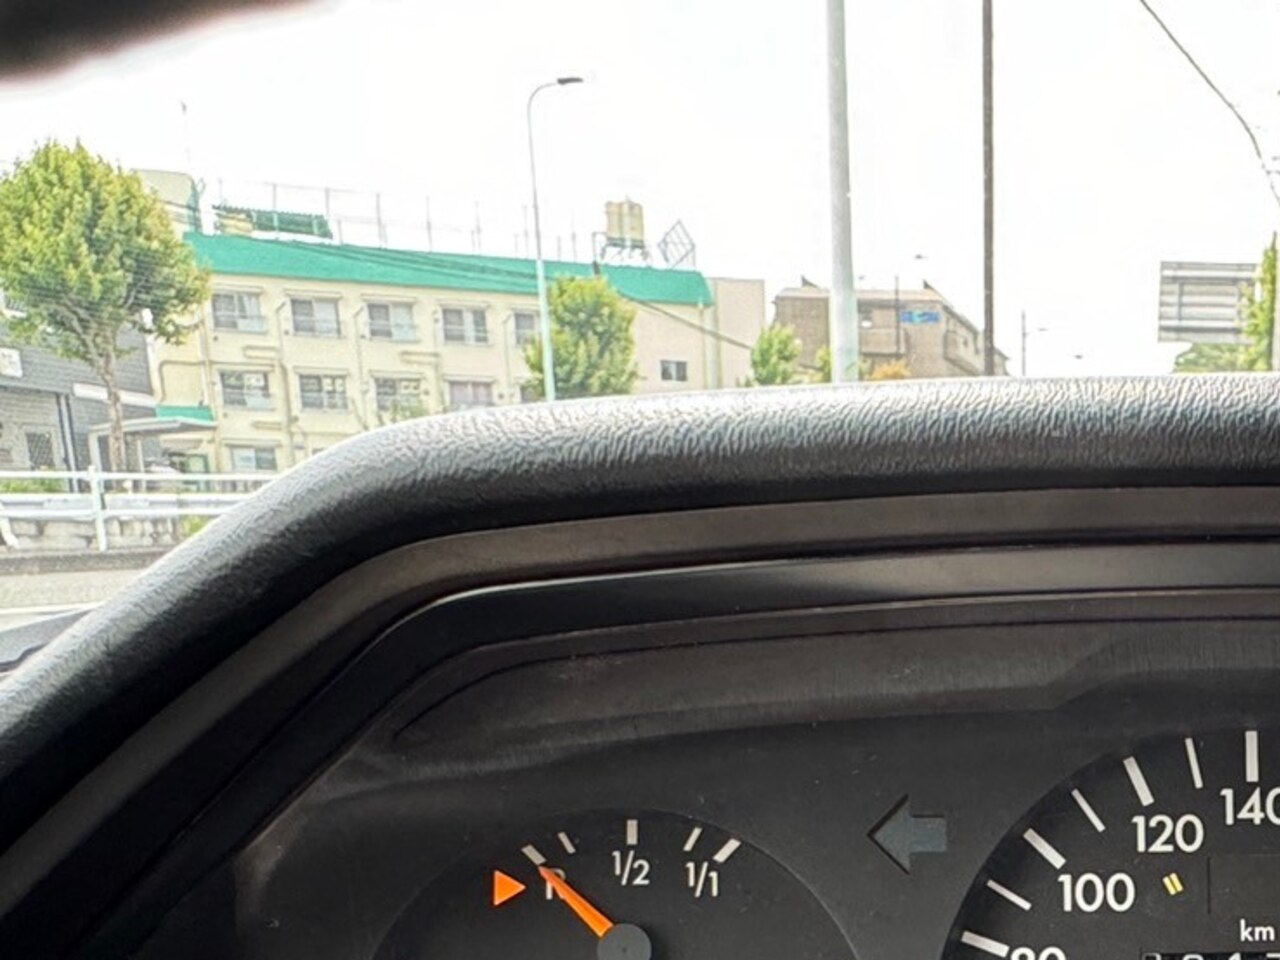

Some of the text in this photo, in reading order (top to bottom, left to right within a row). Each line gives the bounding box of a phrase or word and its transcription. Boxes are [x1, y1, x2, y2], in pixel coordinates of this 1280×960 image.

[1132, 814, 1204, 853] 120
[612, 850, 650, 886] 1/2
[685, 860, 719, 899] 1/1
[1057, 872, 1135, 912] 100
[1240, 918, 1275, 942] km
